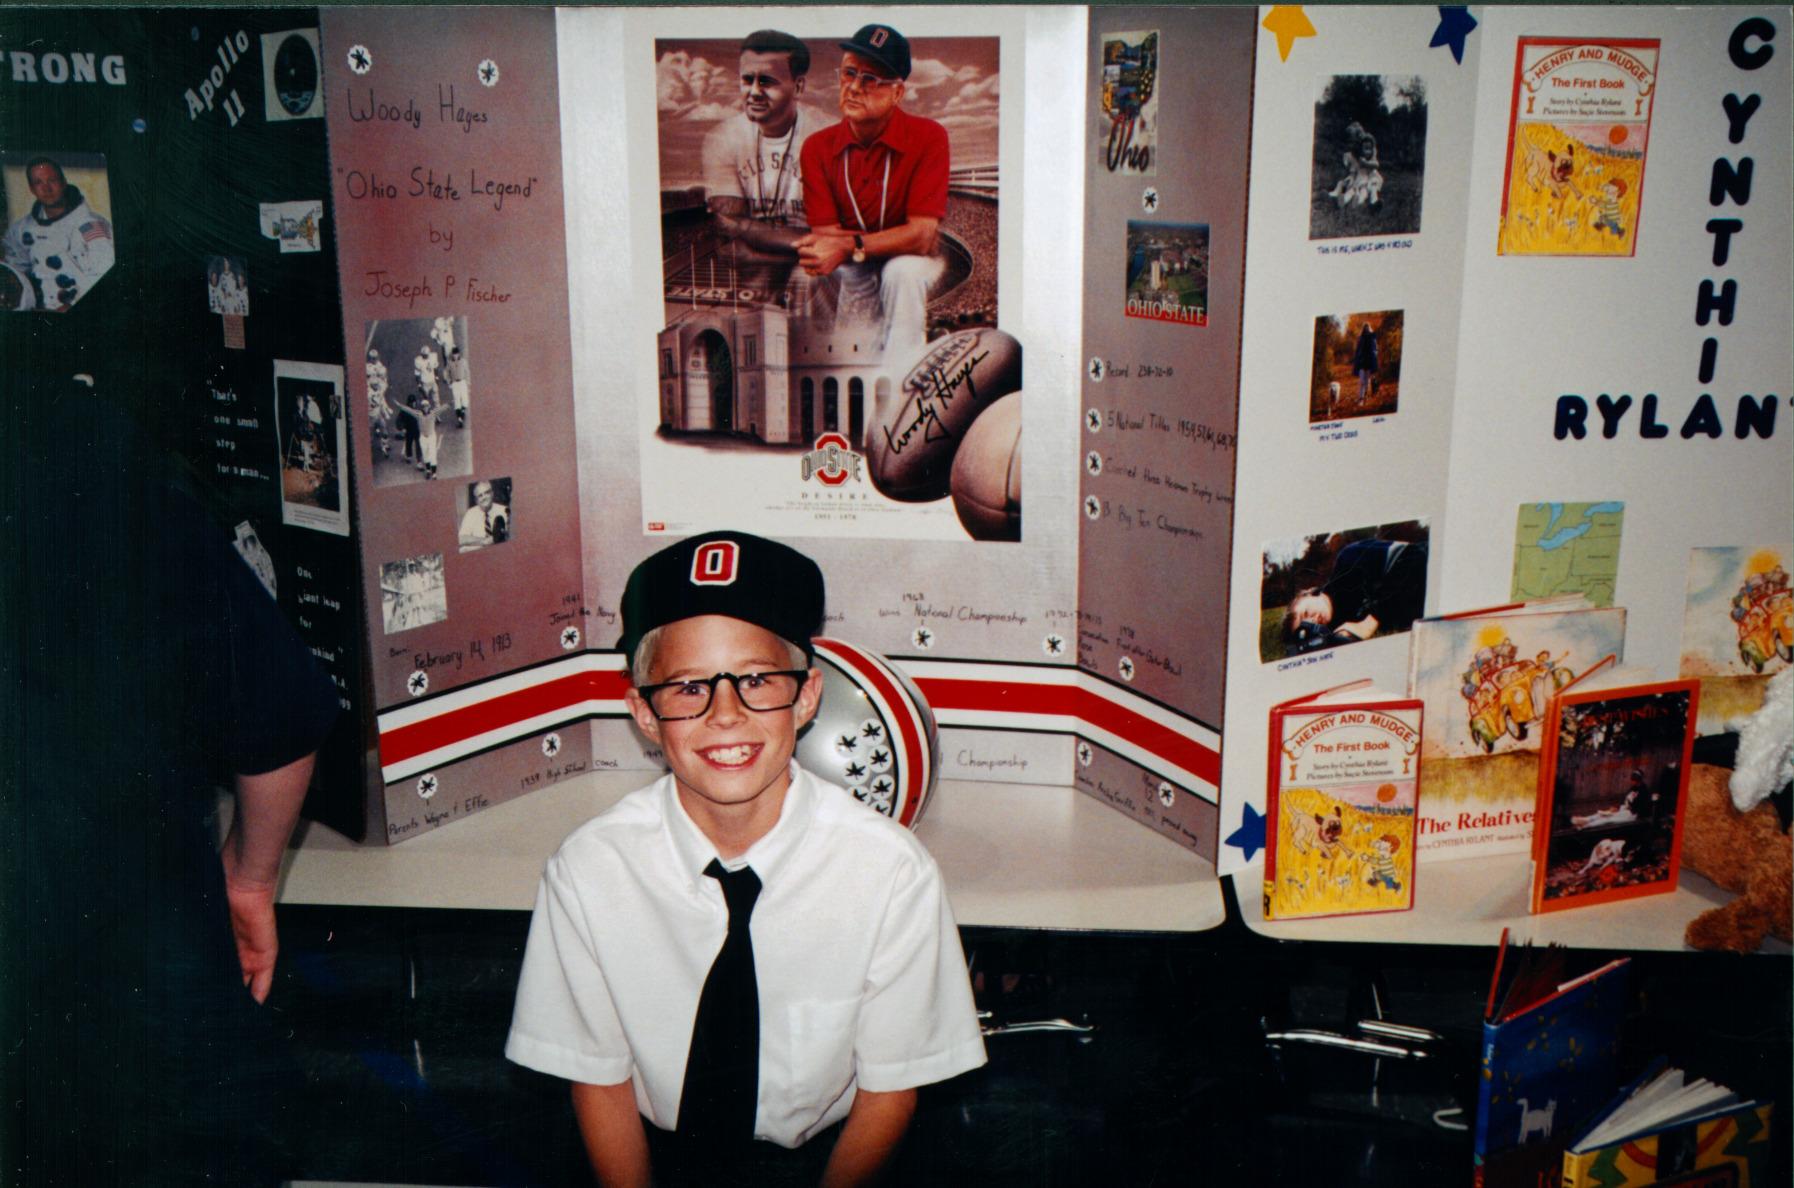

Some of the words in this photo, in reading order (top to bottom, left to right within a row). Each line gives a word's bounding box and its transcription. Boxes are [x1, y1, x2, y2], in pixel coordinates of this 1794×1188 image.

[0, 51, 127, 84] RONG
[184, 29, 250, 120] Apollo
[1535, 50, 1575, 79] HENRY
[1578, 48, 1604, 60] AND
[1607, 52, 1648, 82] MUDGE
[1551, 77, 1571, 88] The
[1573, 77, 1597, 89] First
[1599, 78, 1625, 89] Book
[347, 87, 422, 129] Woody
[438, 83, 488, 133] Hayes
[1106, 114, 1149, 172] Ohio
[408, 166, 461, 201] State
[429, 222, 454, 251] by
[364, 271, 432, 309] Joseph
[445, 276, 455, 297] P
[466, 278, 513, 303] Fischer
[1127, 298, 1163, 317] OHIO
[1164, 303, 1206, 324] STATE
[884, 390, 949, 455] Woody
[1554, 393, 1794, 440] RYLAN
[216, 438, 236, 452] step
[690, 541, 740, 586] O
[822, 611, 845, 622] oach
[913, 602, 953, 618] National
[957, 605, 1028, 624] Championship
[413, 651, 463, 670] February
[1295, 717, 1337, 748] HENRY
[1339, 714, 1366, 725] AND
[1369, 714, 1414, 743] MUDGE
[1314, 744, 1334, 753] The
[1336, 742, 1361, 753] First
[1363, 741, 1390, 752] Book
[957, 749, 1028, 770] Championship
[1419, 817, 1451, 835] The
